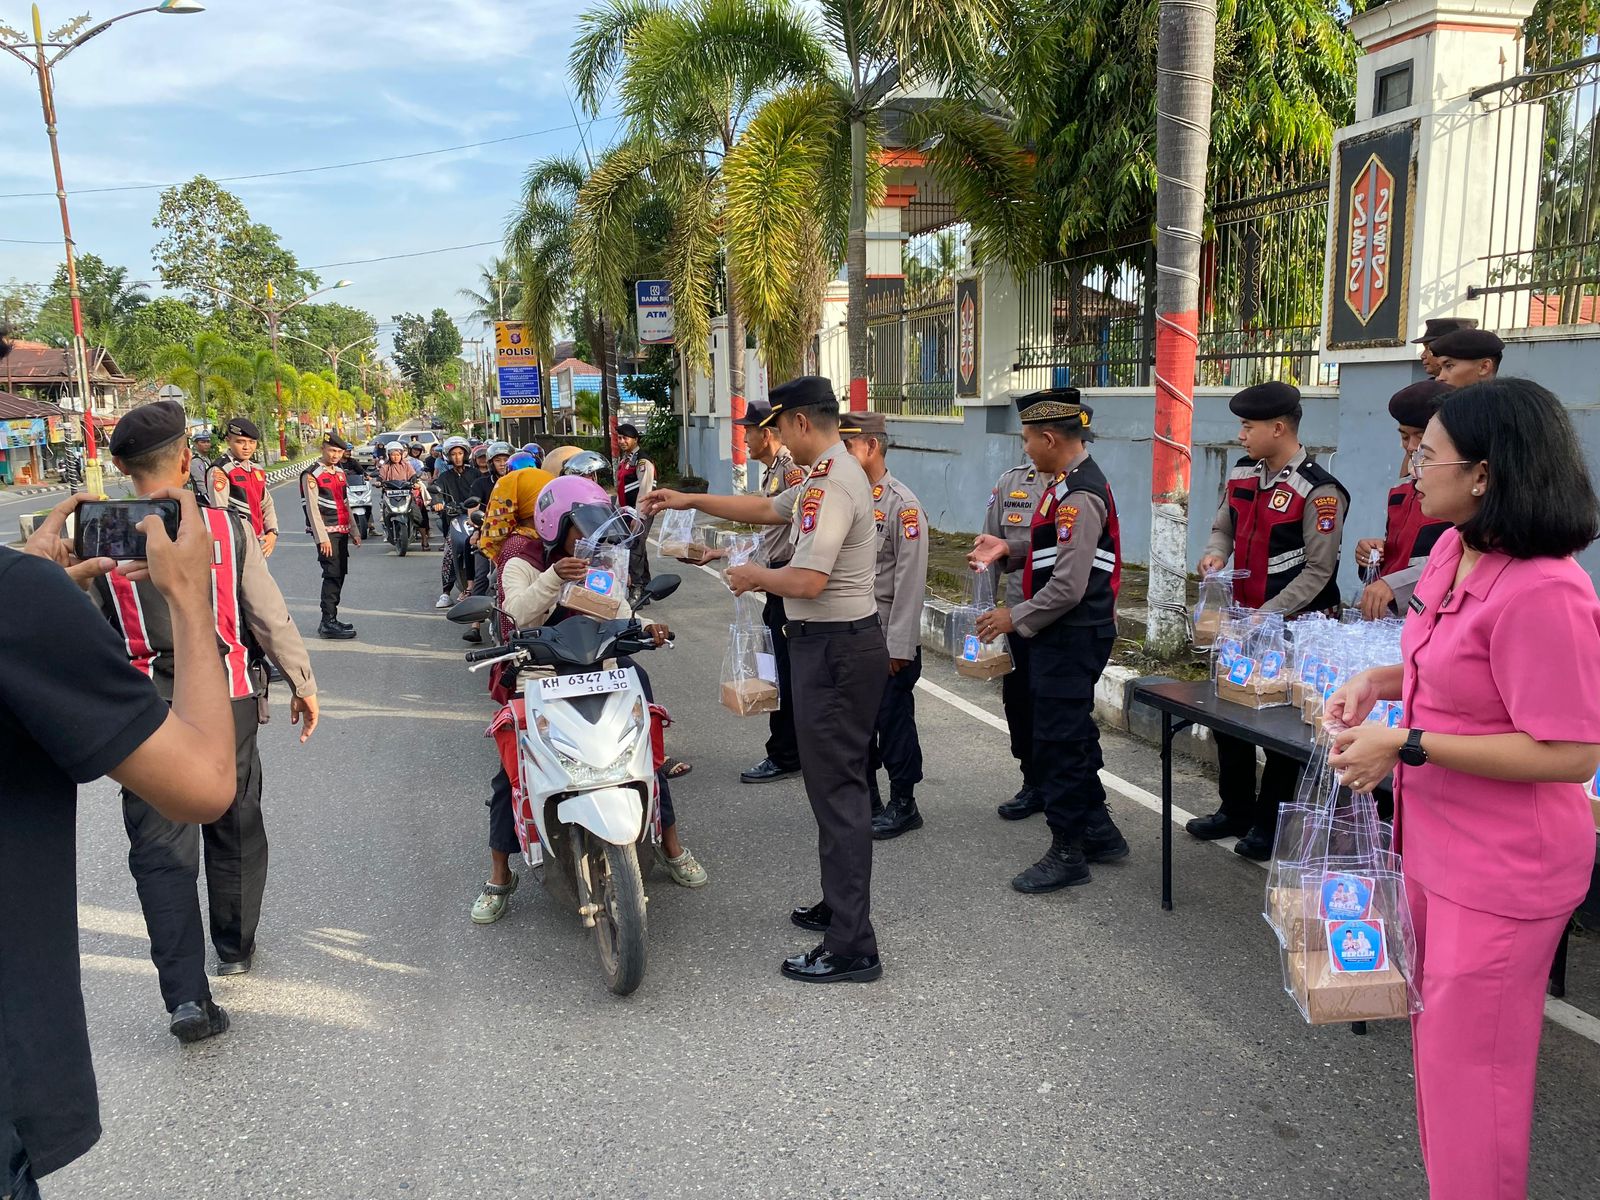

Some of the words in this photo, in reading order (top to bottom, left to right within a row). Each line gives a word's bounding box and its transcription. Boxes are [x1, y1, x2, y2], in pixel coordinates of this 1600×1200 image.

[499, 347, 534, 356] POLISI
[542, 677, 560, 689] KH
[568, 673, 602, 685] 6347
